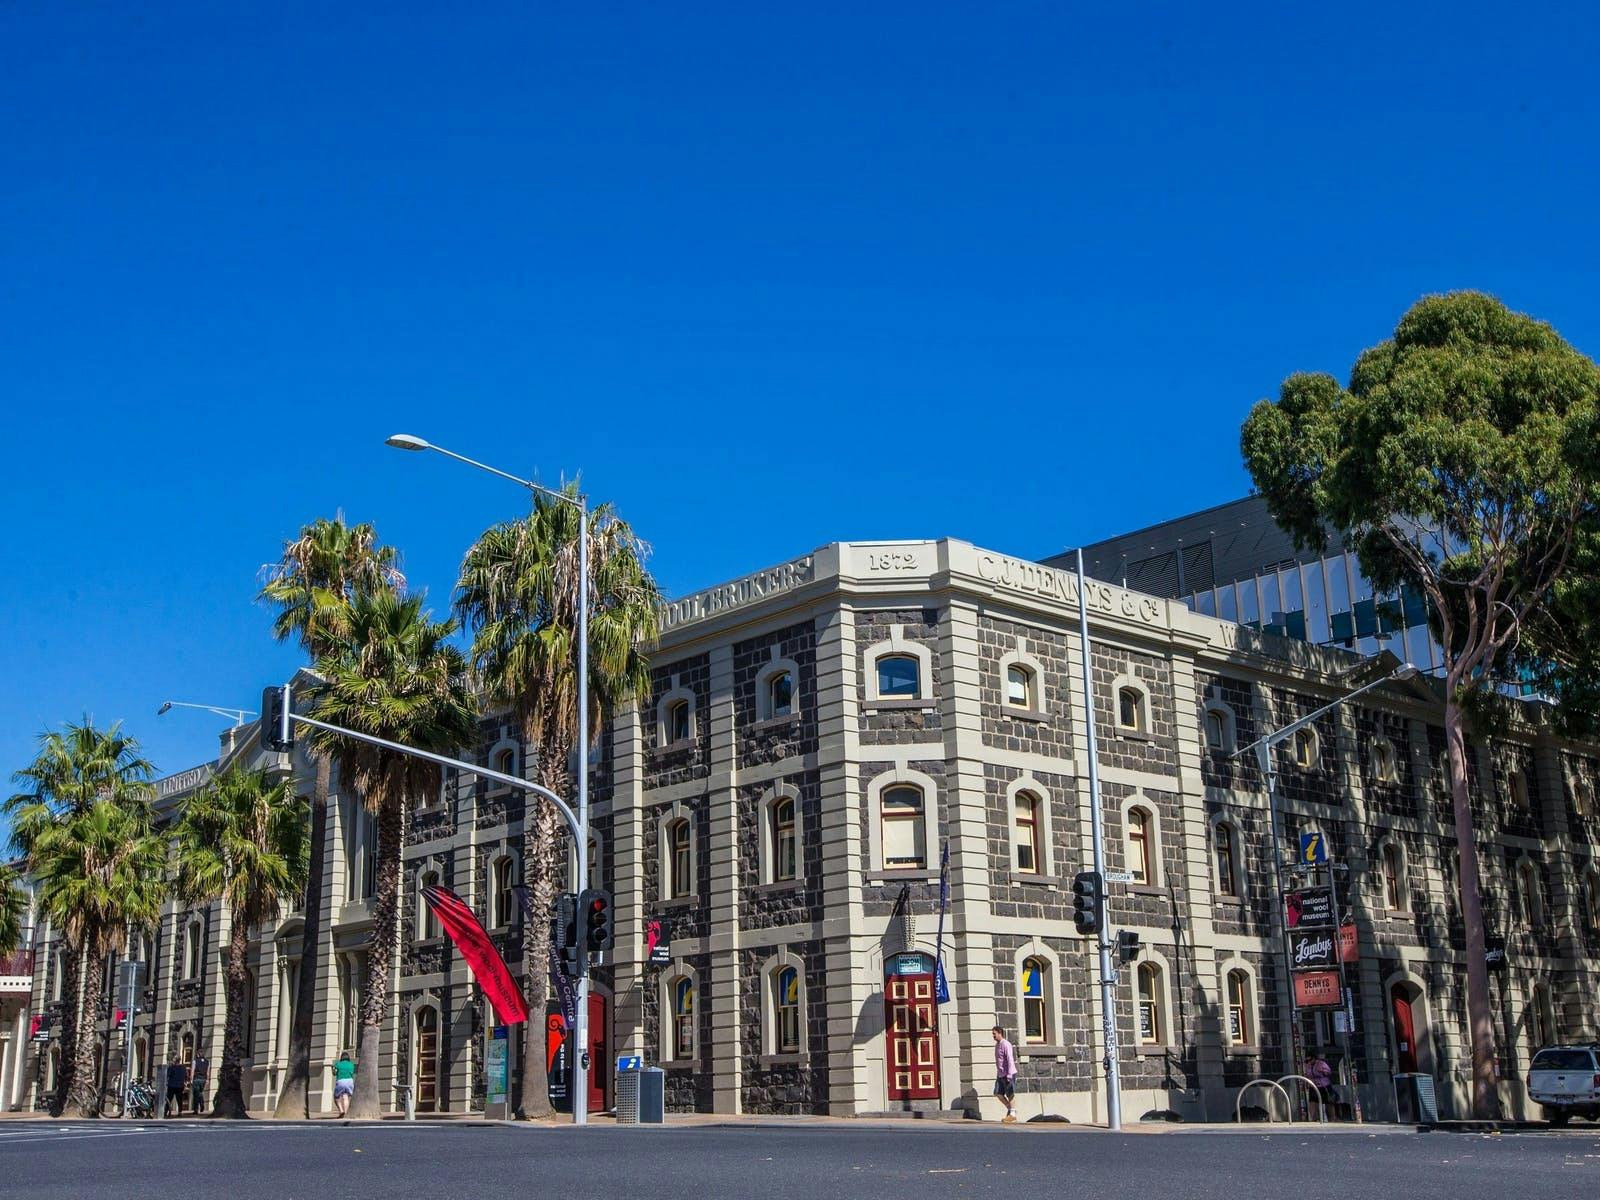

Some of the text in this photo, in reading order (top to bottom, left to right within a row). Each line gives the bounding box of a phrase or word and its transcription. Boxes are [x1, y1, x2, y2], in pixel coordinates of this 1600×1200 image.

[870, 553, 918, 571] 1872
[708, 557, 811, 614] BROKERS
[1121, 593, 1136, 617] &
[1302, 896, 1328, 905] national
[1313, 904, 1329, 912] wool
[1302, 912, 1330, 921] museum
[1304, 978, 1330, 989] DENNYS
[495, 971, 520, 1017] museum
